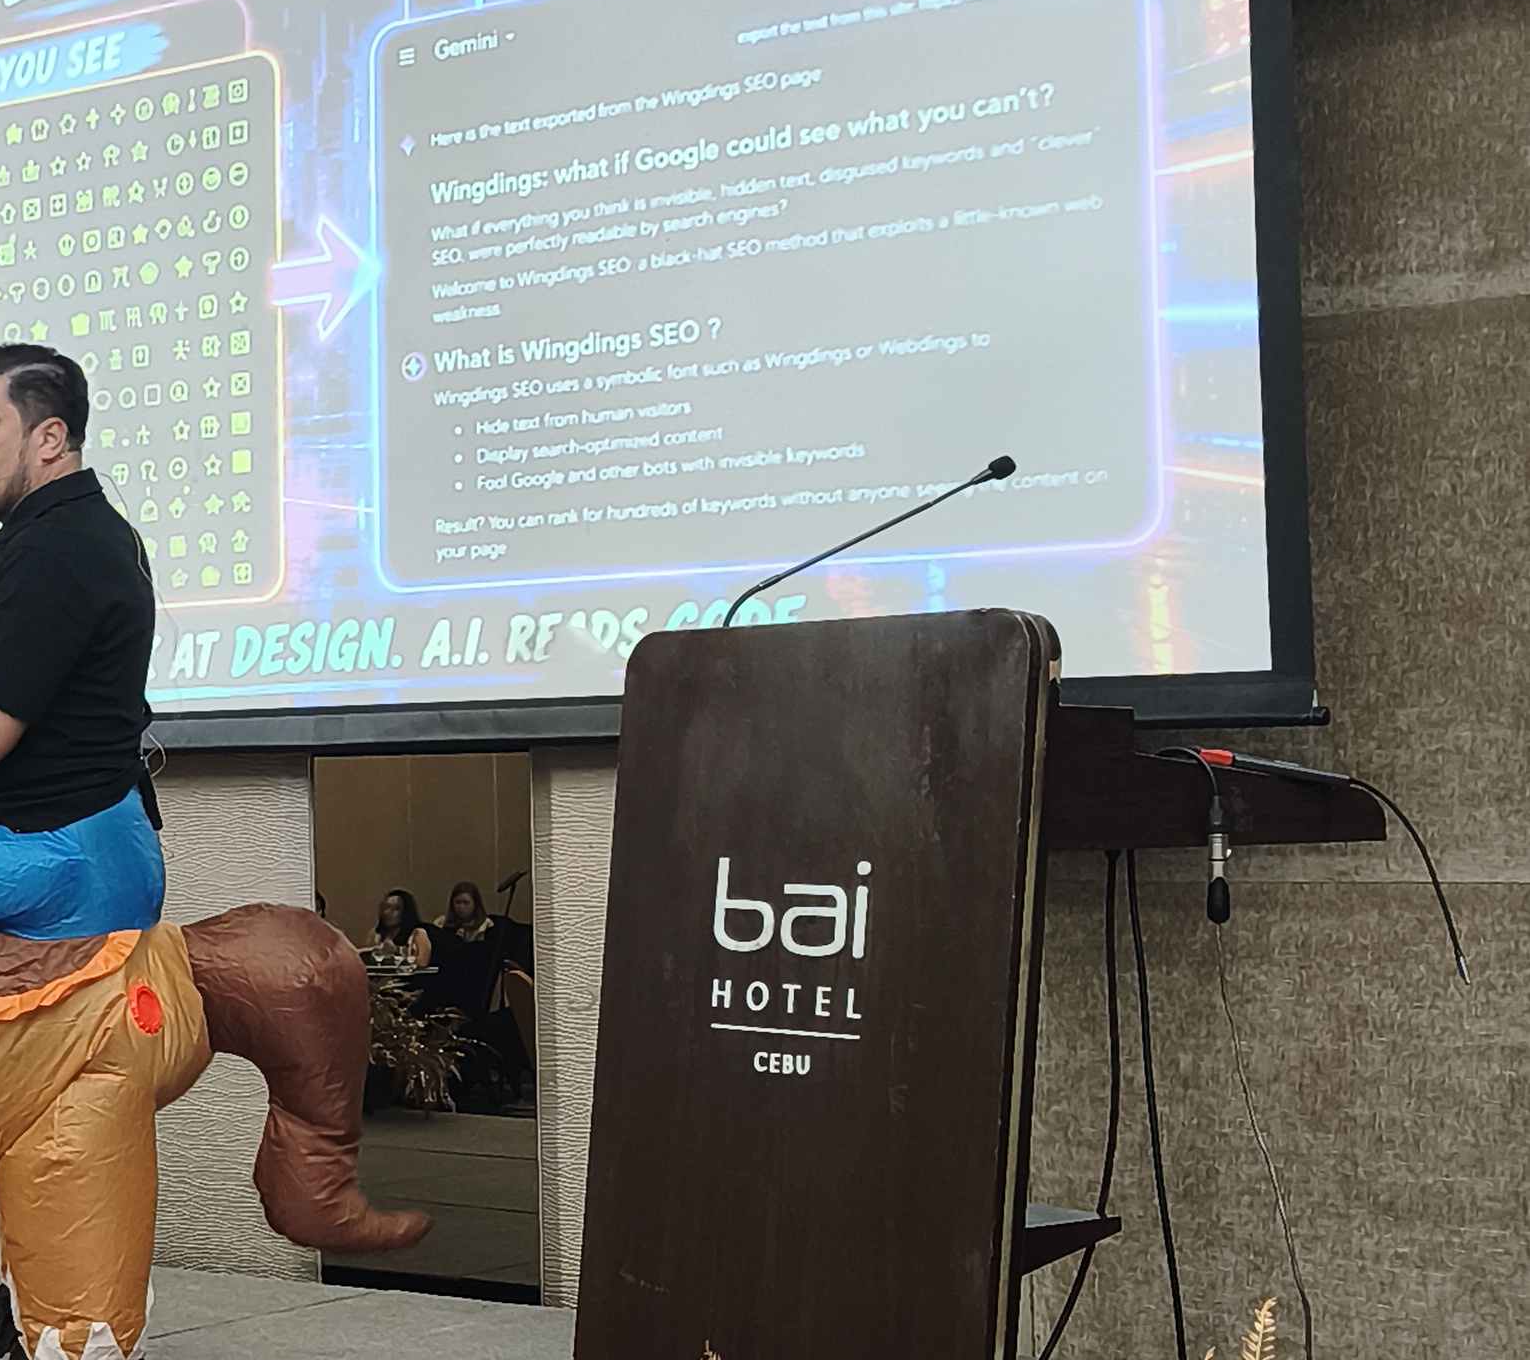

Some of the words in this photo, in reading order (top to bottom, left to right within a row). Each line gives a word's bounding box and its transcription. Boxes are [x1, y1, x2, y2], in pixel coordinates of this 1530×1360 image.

[66, 30, 124, 74] SEE
[434, 31, 498, 59] Gemini
[430, 132, 463, 147] Here
[479, 123, 501, 139] the
[504, 118, 530, 134] text
[533, 104, 596, 130] exported
[598, 100, 632, 118] from
[635, 95, 659, 112] the
[661, 81, 740, 107] Wingdings
[744, 72, 778, 93] SEO
[780, 68, 823, 90] page
[431, 169, 549, 205] Wingdings:
[554, 156, 609, 185] what
[614, 150, 629, 174] if
[634, 138, 719, 171] Google
[726, 126, 791, 157] could
[799, 122, 841, 145] see
[847, 108, 910, 138] what
[917, 102, 966, 133] you
[972, 82, 1055, 118] can't?
[431, 225, 467, 242] What
[483, 210, 559, 233] everything
[562, 206, 590, 226] you
[593, 199, 629, 217] think
[634, 198, 646, 211] is
[720, 177, 776, 197] hidden
[819, 156, 898, 184] disguised
[902, 145, 984, 172] keywords
[990, 138, 1024, 158] and
[432, 277, 496, 299] Welcome
[499, 276, 514, 289] to
[517, 265, 594, 287] Wingdings
[637, 258, 647, 271] a
[651, 247, 723, 269] black-hat
[726, 238, 762, 260] SEO
[764, 230, 828, 252] method
[831, 225, 864, 242] that
[867, 216, 934, 238] exploits
[938, 216, 948, 229] a
[1063, 195, 1102, 212] web
[468, 244, 502, 260] were
[505, 234, 569, 258] perfectly
[572, 223, 637, 245] readable
[640, 219, 659, 237] by
[662, 213, 713, 233] search
[717, 198, 788, 225] engines?
[434, 348, 491, 373] What
[498, 344, 515, 364] is
[521, 330, 642, 363] Wingdings
[649, 319, 699, 347] SEO
[707, 317, 721, 340] ?
[434, 385, 508, 408] Wingdings
[512, 380, 543, 398] SEO
[546, 378, 580, 393] uses
[583, 376, 593, 389] a
[597, 367, 663, 391] symbolic
[667, 363, 698, 379] font
[702, 359, 739, 376] such
[742, 356, 761, 372] as
[765, 347, 852, 370] Wingdings
[855, 345, 873, 359] or
[878, 334, 968, 356] Webdings
[476, 419, 510, 435] Hide
[513, 415, 540, 432] text
[544, 410, 579, 427] from
[581, 407, 634, 424] human
[637, 400, 692, 418] visitors
[476, 447, 528, 464] Display
[532, 431, 660, 459] search-optimized
[664, 427, 723, 446] content
[476, 475, 508, 491] Fool
[511, 470, 566, 490] Google
[568, 466, 597, 484] and
[599, 463, 640, 480] other
[643, 460, 677, 477] bots
[681, 455, 715, 472] with
[718, 449, 783, 468] invisible
[786, 442, 866, 465] keywords
[435, 515, 485, 534] Result?
[488, 513, 515, 530] You
[518, 512, 544, 528] can
[548, 509, 578, 525] rank
[582, 505, 604, 521] for
[607, 500, 678, 520] hundreds
[682, 498, 698, 513] of
[701, 492, 777, 516] keywords
[781, 488, 842, 506] without
[847, 485, 911, 504] anyone
[1010, 470, 1079, 489] content
[1084, 470, 1109, 484] on
[436, 545, 467, 564] your
[470, 542, 508, 561] page
[169, 630, 220, 680] AT
[230, 617, 403, 678] DESIGN.
[421, 617, 490, 668] A.I.
[713, 857, 872, 960] bai
[711, 978, 862, 1020] HOTEL
[753, 1051, 811, 1076] CEBU
